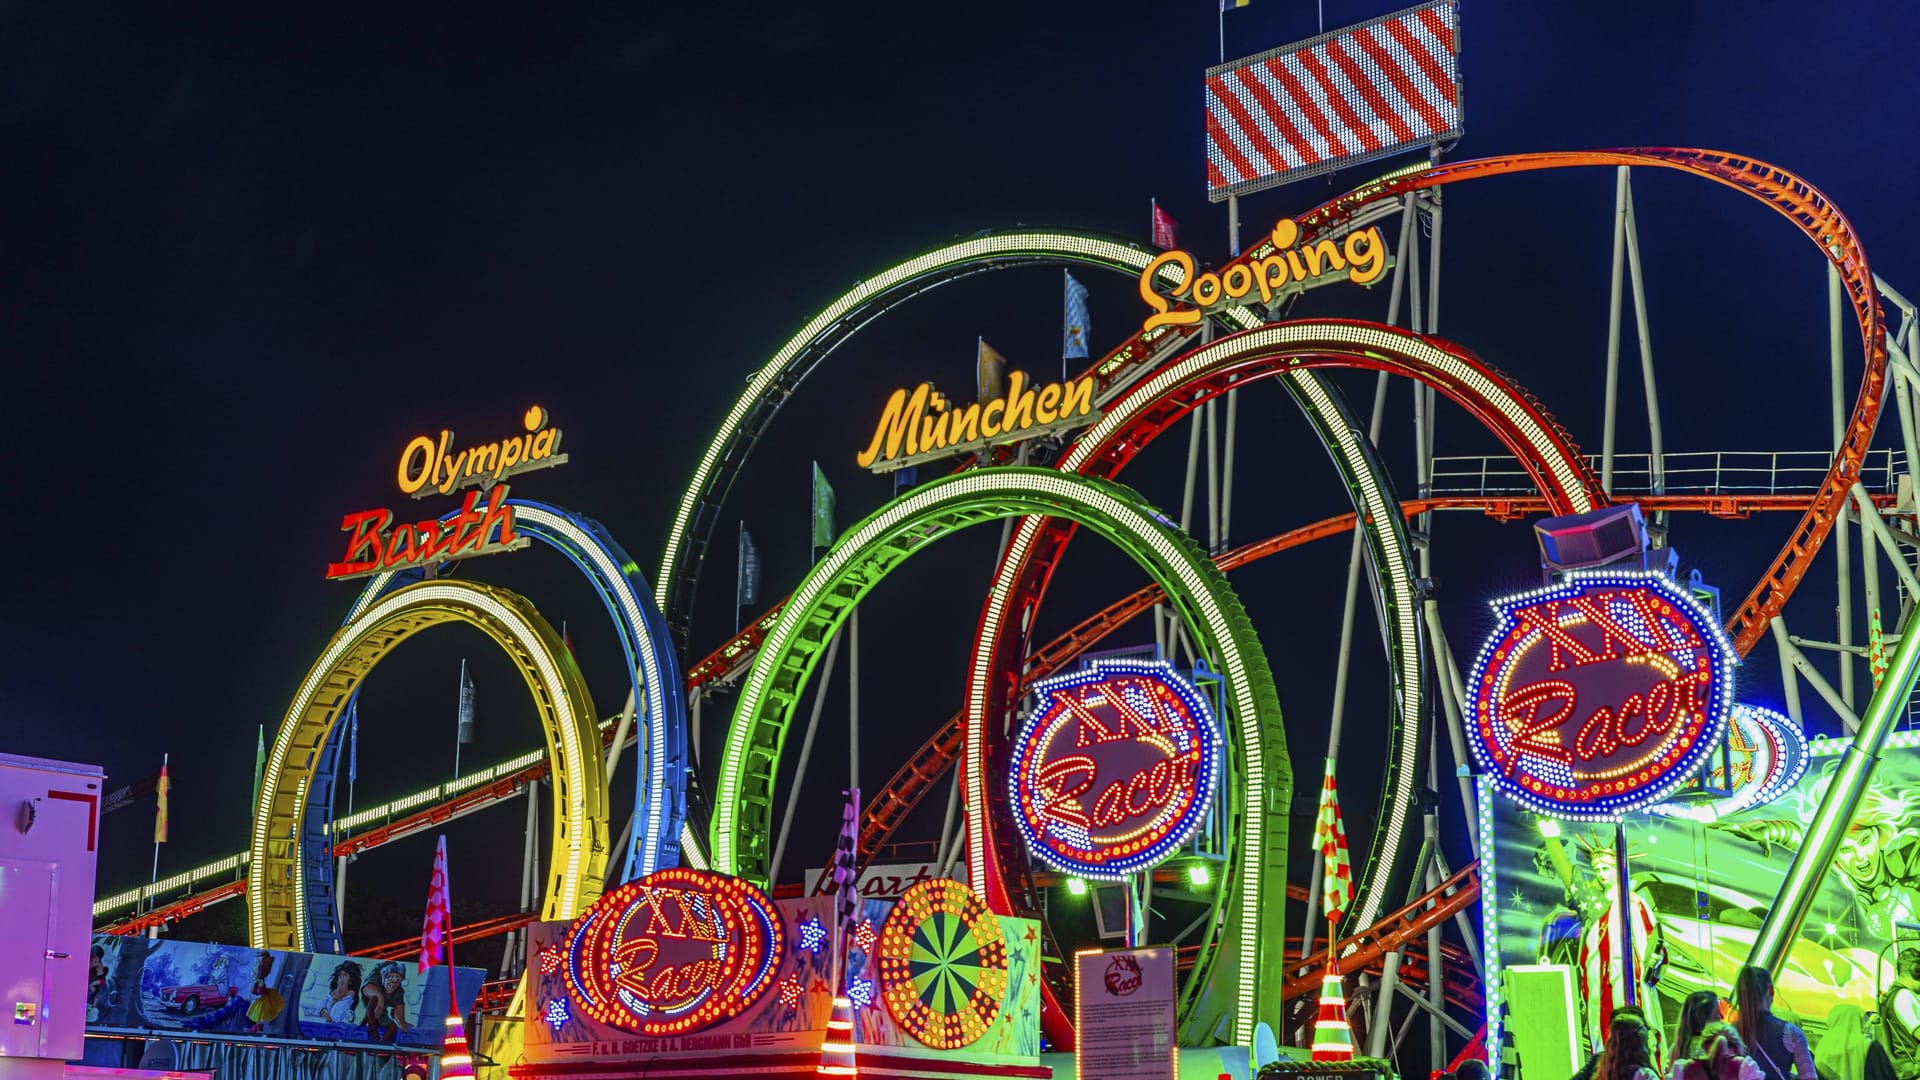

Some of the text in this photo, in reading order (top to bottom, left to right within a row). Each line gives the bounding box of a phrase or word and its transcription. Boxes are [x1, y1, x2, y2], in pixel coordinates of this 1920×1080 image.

[1139, 217, 1391, 332] Looping
[397, 404, 562, 495] Olympia
[856, 370, 1099, 469] München
[325, 484, 520, 580] Barth
[1512, 586, 1703, 672] XXL
[1050, 677, 1196, 748] XXL
[1497, 670, 1705, 778] Racer
[1034, 751, 1195, 840] Racer
[639, 884, 731, 943] XXL
[610, 937, 726, 1003] Racer
[622, 1039, 660, 1055] GOETZKE
[661, 1040, 668, 1052] &
[668, 1039, 679, 1052] A.
[681, 1034, 732, 1052] BERGMANN
